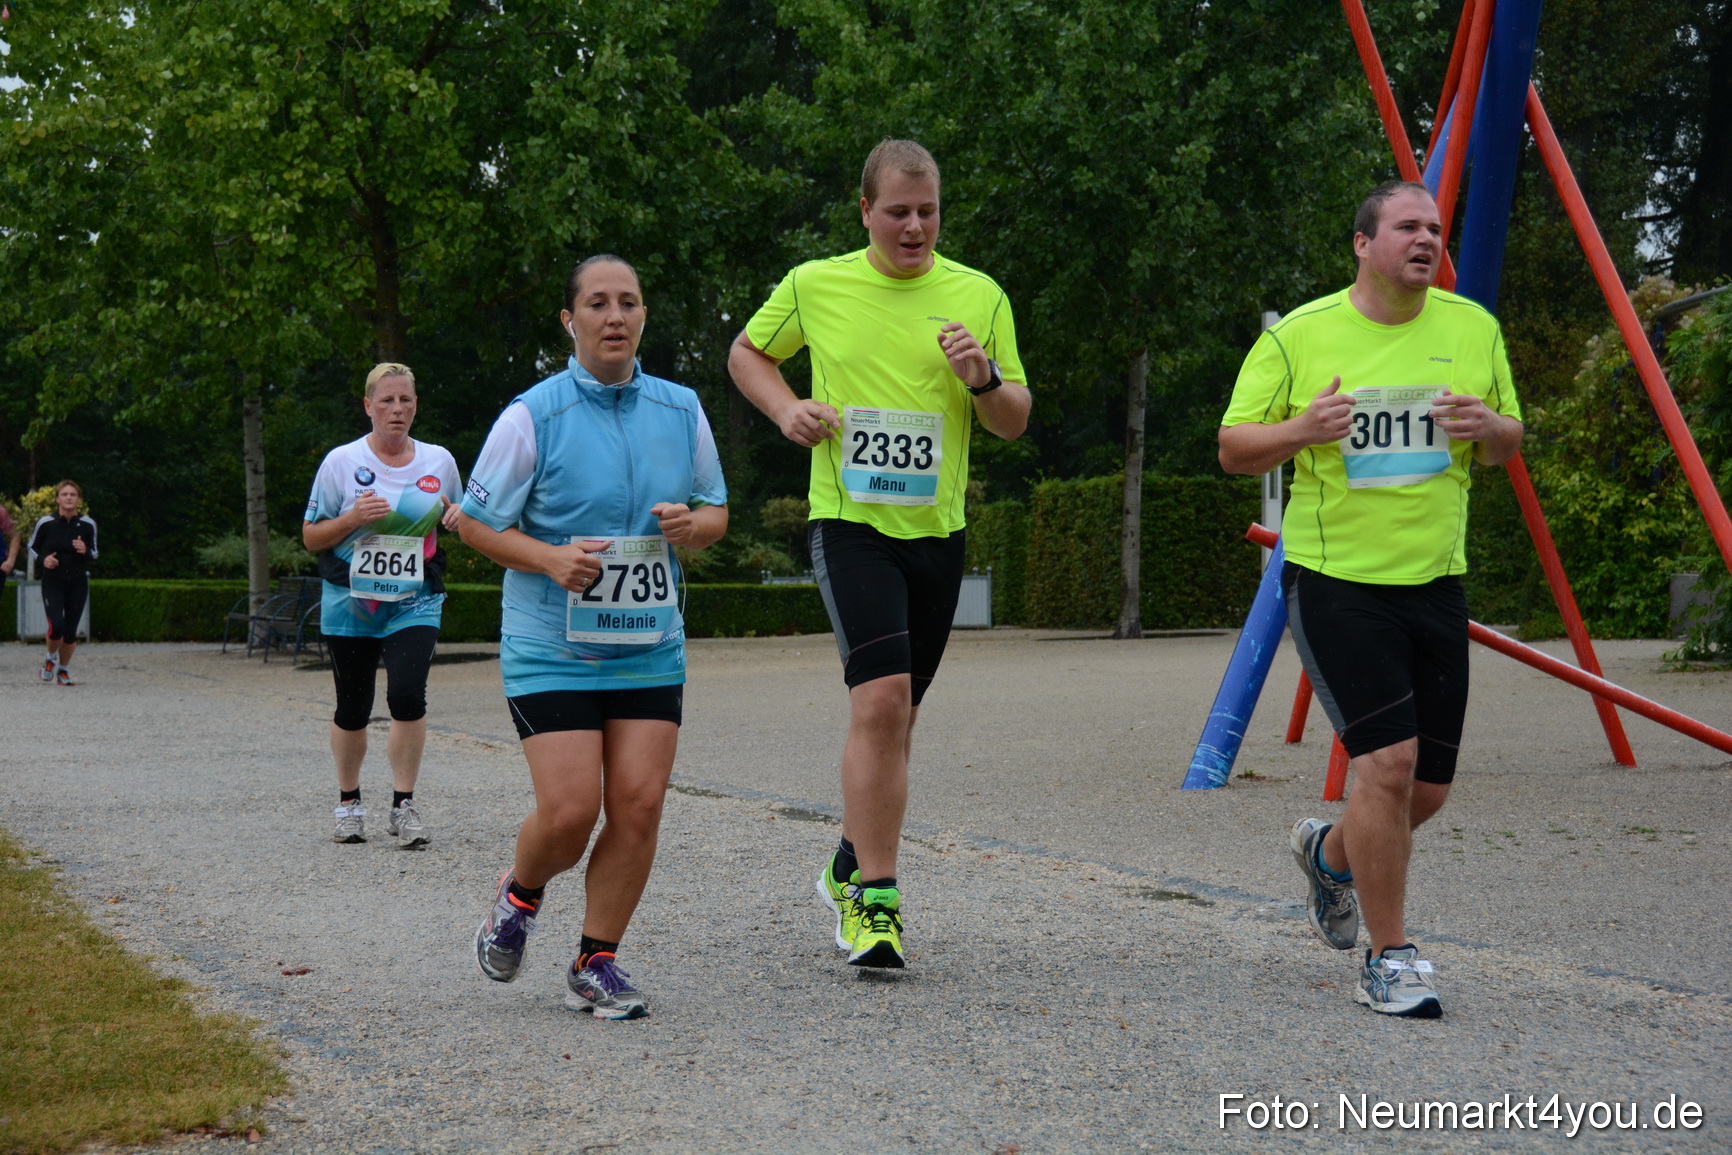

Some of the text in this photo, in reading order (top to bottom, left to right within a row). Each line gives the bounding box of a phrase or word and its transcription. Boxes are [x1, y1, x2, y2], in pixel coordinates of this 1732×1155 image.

[1388, 389, 1438, 401] BOCK
[886, 412, 935, 427] BOCK
[1350, 410, 1434, 449] 3011
[851, 430, 933, 470] 2333
[869, 476, 906, 492] Manu
[624, 540, 662, 553] BOCK
[358, 550, 417, 577] 2664
[374, 581, 399, 593] Petra
[582, 562, 668, 602] 2739
[597, 613, 656, 629] Melanie
